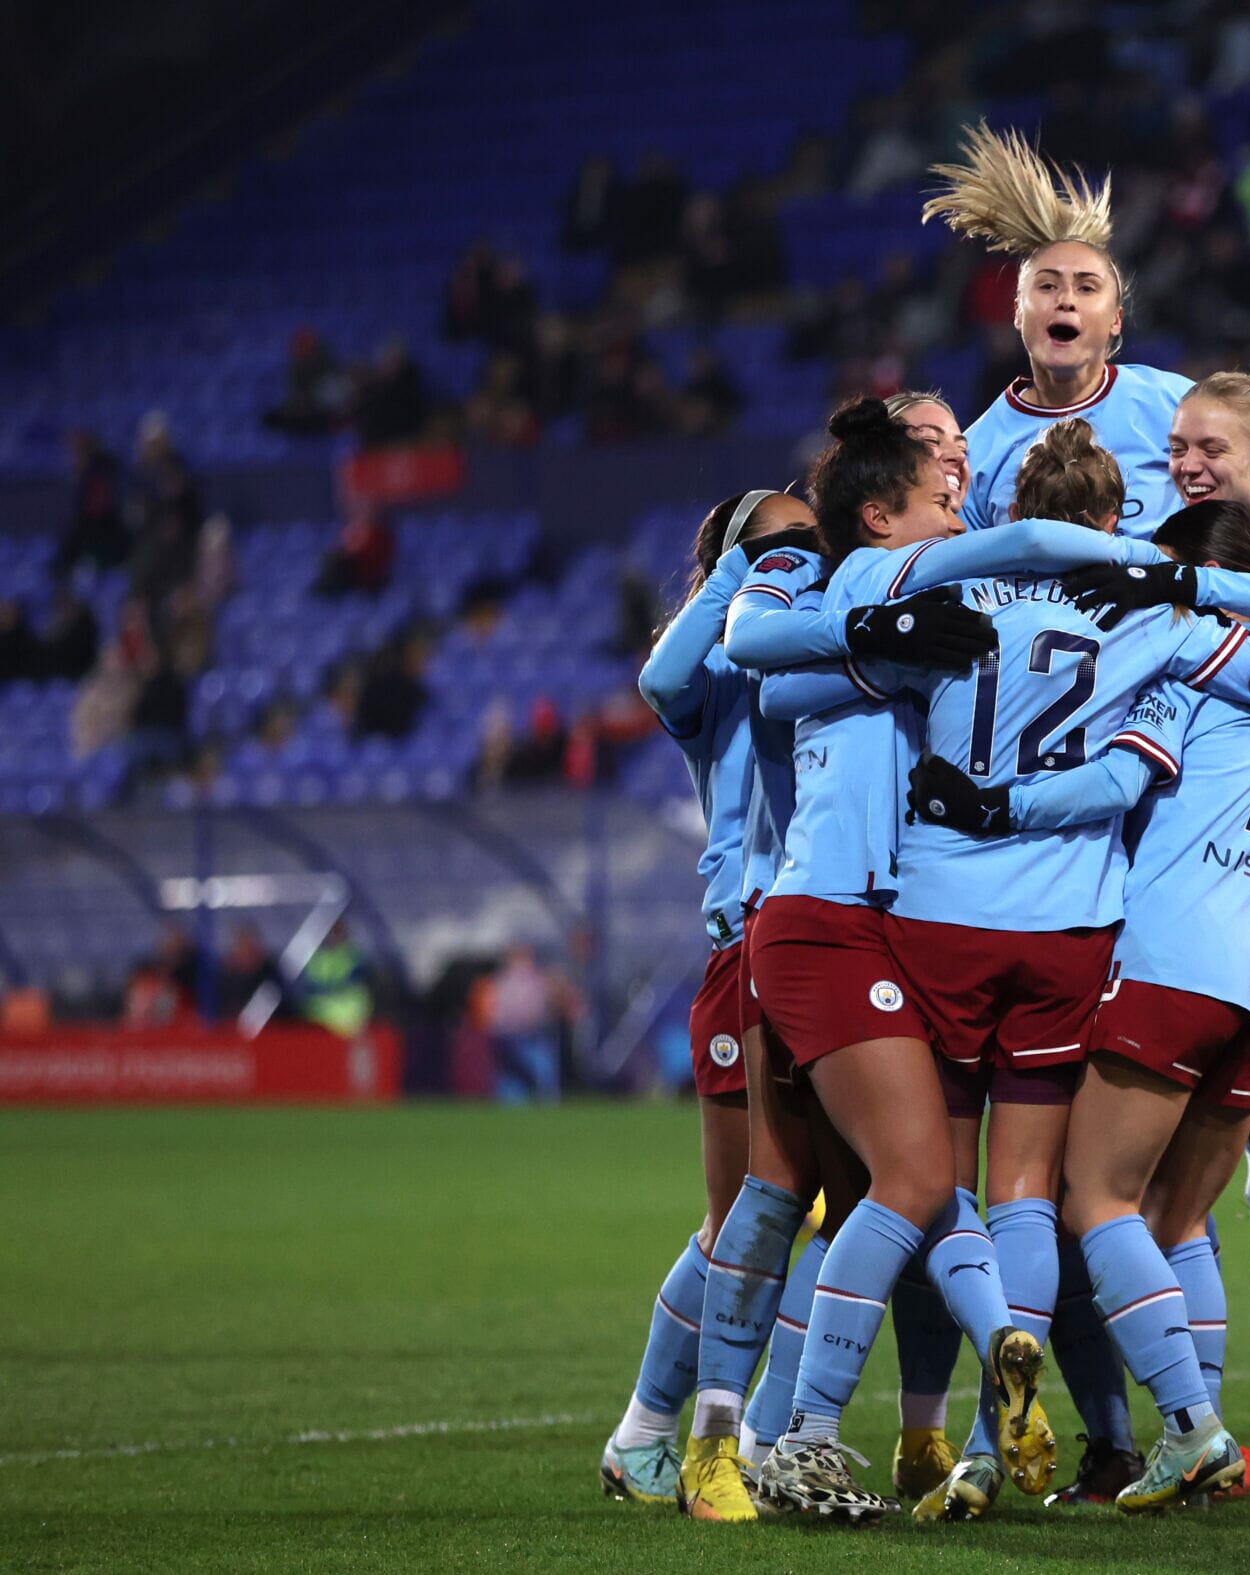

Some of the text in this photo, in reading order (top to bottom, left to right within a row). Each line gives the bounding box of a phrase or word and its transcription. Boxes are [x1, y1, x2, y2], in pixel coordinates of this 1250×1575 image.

[969, 628, 1102, 777] 12
[1135, 693, 1177, 721] EXEN
[1131, 707, 1164, 731] TIRE
[715, 1312, 763, 1331] CITY
[823, 1333, 867, 1354] CITY
